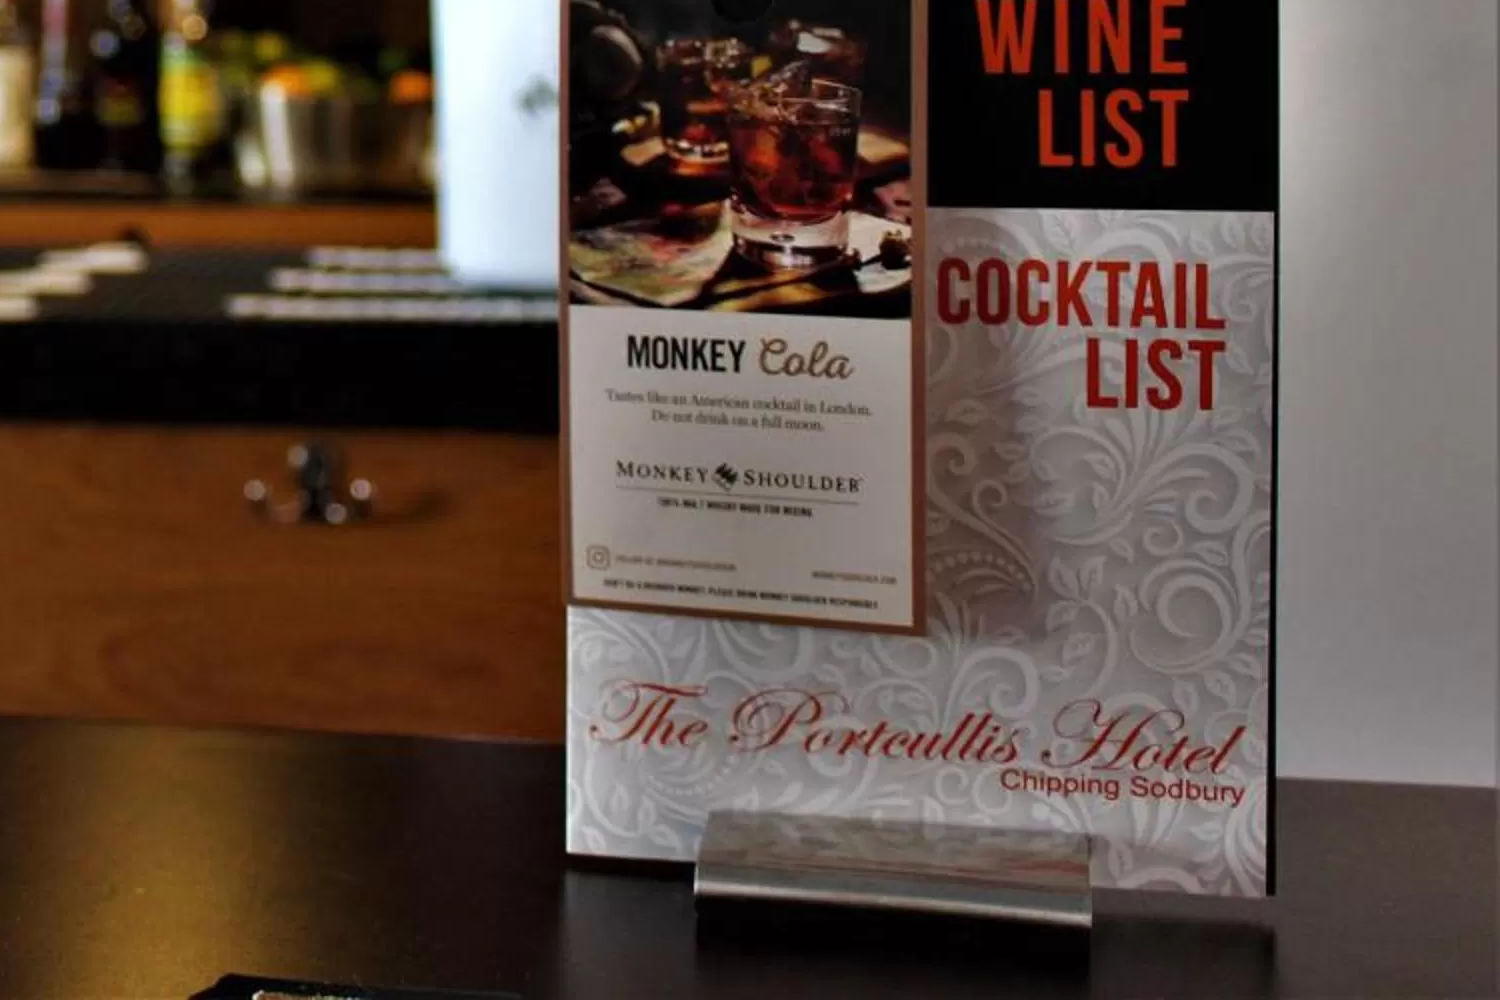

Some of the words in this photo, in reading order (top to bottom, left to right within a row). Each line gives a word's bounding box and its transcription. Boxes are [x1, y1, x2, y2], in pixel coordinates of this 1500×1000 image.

[1038, 89, 1189, 168] LIST
[937, 257, 1226, 329] COCKTAIL
[627, 335, 746, 373] MONKEY
[758, 337, 855, 380] Cola
[1086, 337, 1226, 410] LIST
[615, 460, 710, 484] MONKEY
[743, 469, 861, 493] SHOULDER
[589, 678, 709, 748] The
[728, 687, 1021, 766] Portcullis
[1040, 697, 1248, 776] Hotel
[999, 767, 1121, 801] Chipping
[1129, 774, 1247, 808] Sodbury
